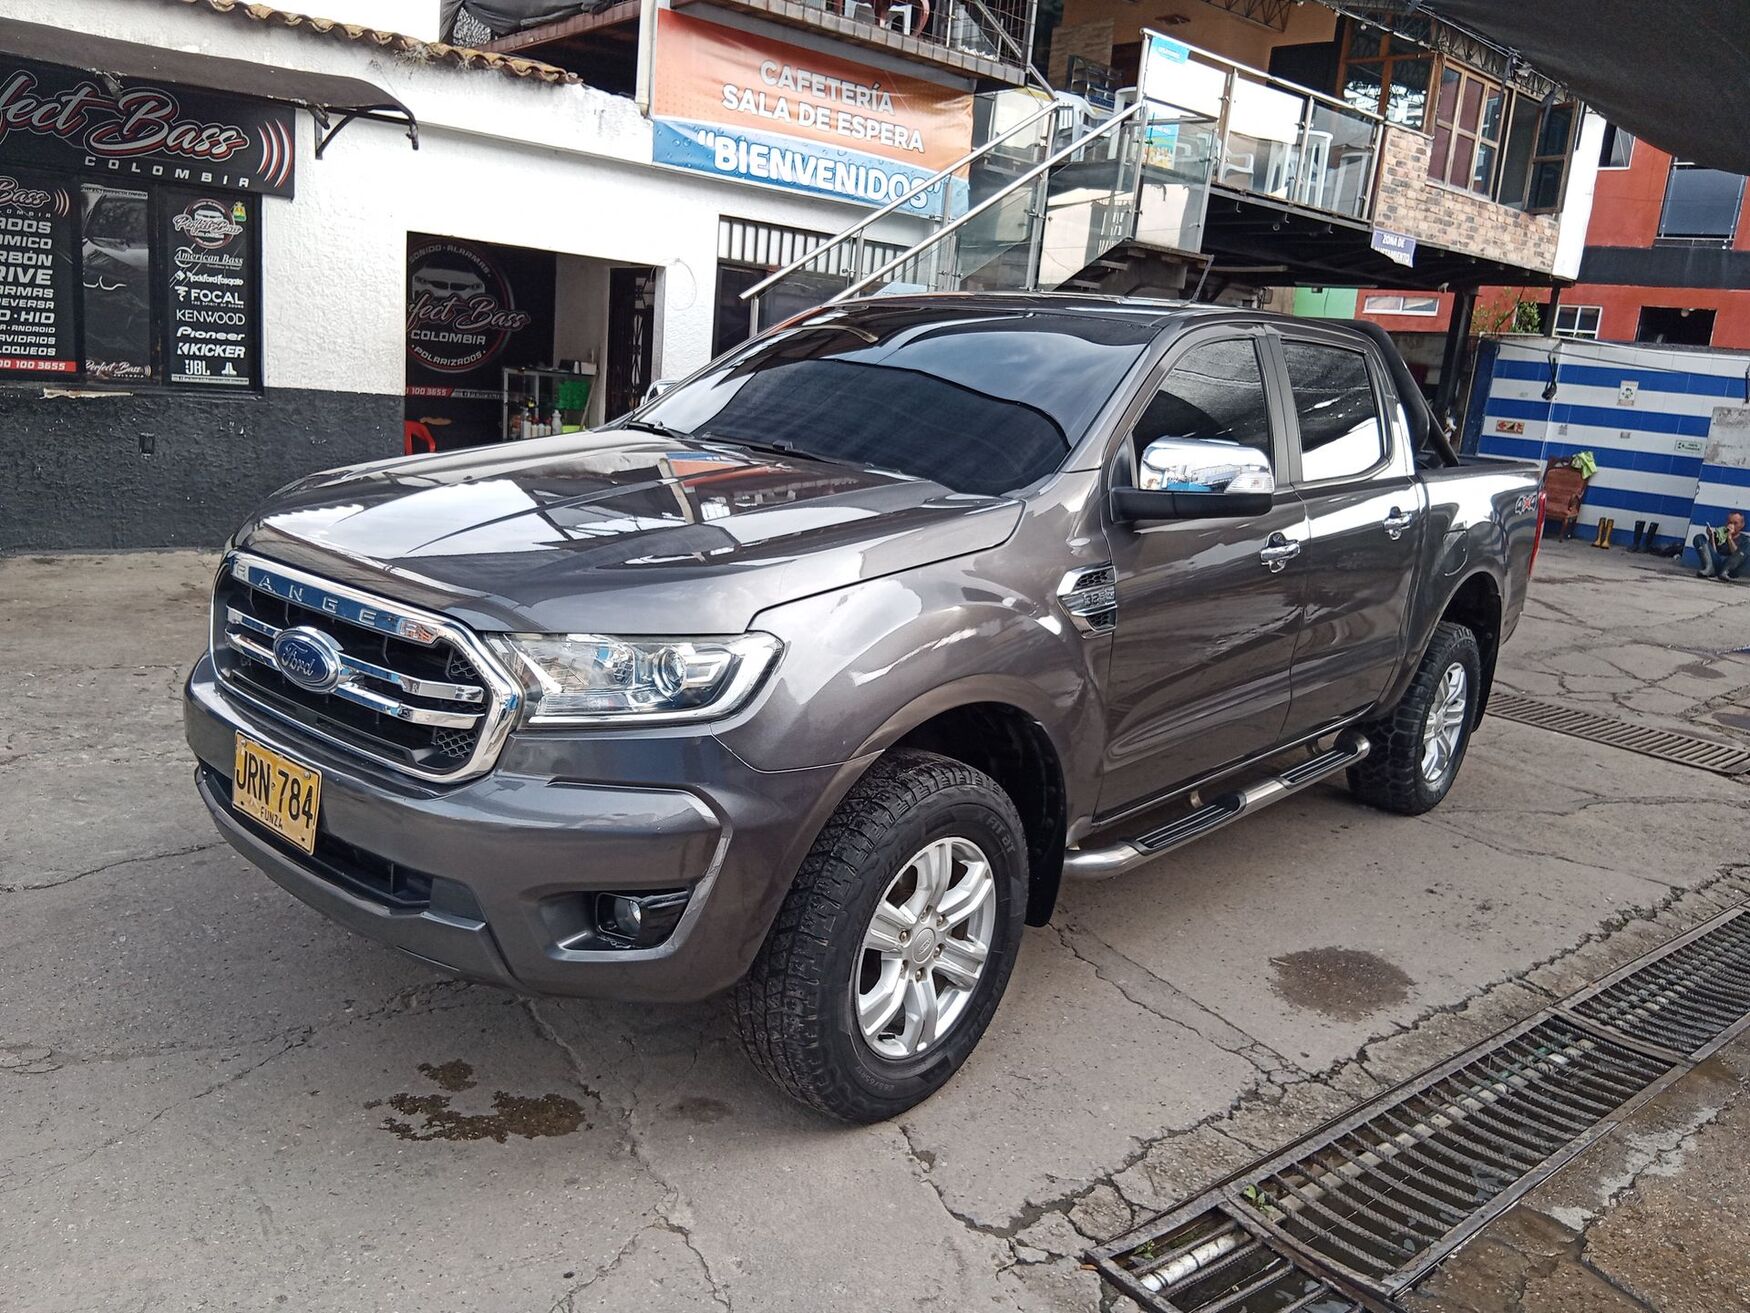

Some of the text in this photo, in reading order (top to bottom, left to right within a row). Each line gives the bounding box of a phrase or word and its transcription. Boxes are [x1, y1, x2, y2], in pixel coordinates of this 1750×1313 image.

[760, 60, 895, 116] CAFETERÍA
[90, 91, 247, 158] Bass
[722, 83, 925, 153] SALA DE ESPERA
[84, 156, 250, 188] COLOMBIA
[0, 234, 52, 249] MICO
[174, 250, 244, 265] American Bass
[0, 298, 55, 310] EVERSA
[190, 289, 244, 304] FOCAL
[176, 309, 246, 325] KENWOOD
[455, 296, 525, 330] Bass
[176, 326, 246, 341] Pioneer
[410, 329, 487, 346] COLOMBIA
[0, 345, 56, 357] OQUEOS
[189, 343, 246, 358] KICKER
[413, 346, 482, 367] POLARIZADOS
[185, 360, 211, 376] JBL
[280, 643, 315, 677] Ford
[260, 806, 284, 831] FUNZA
